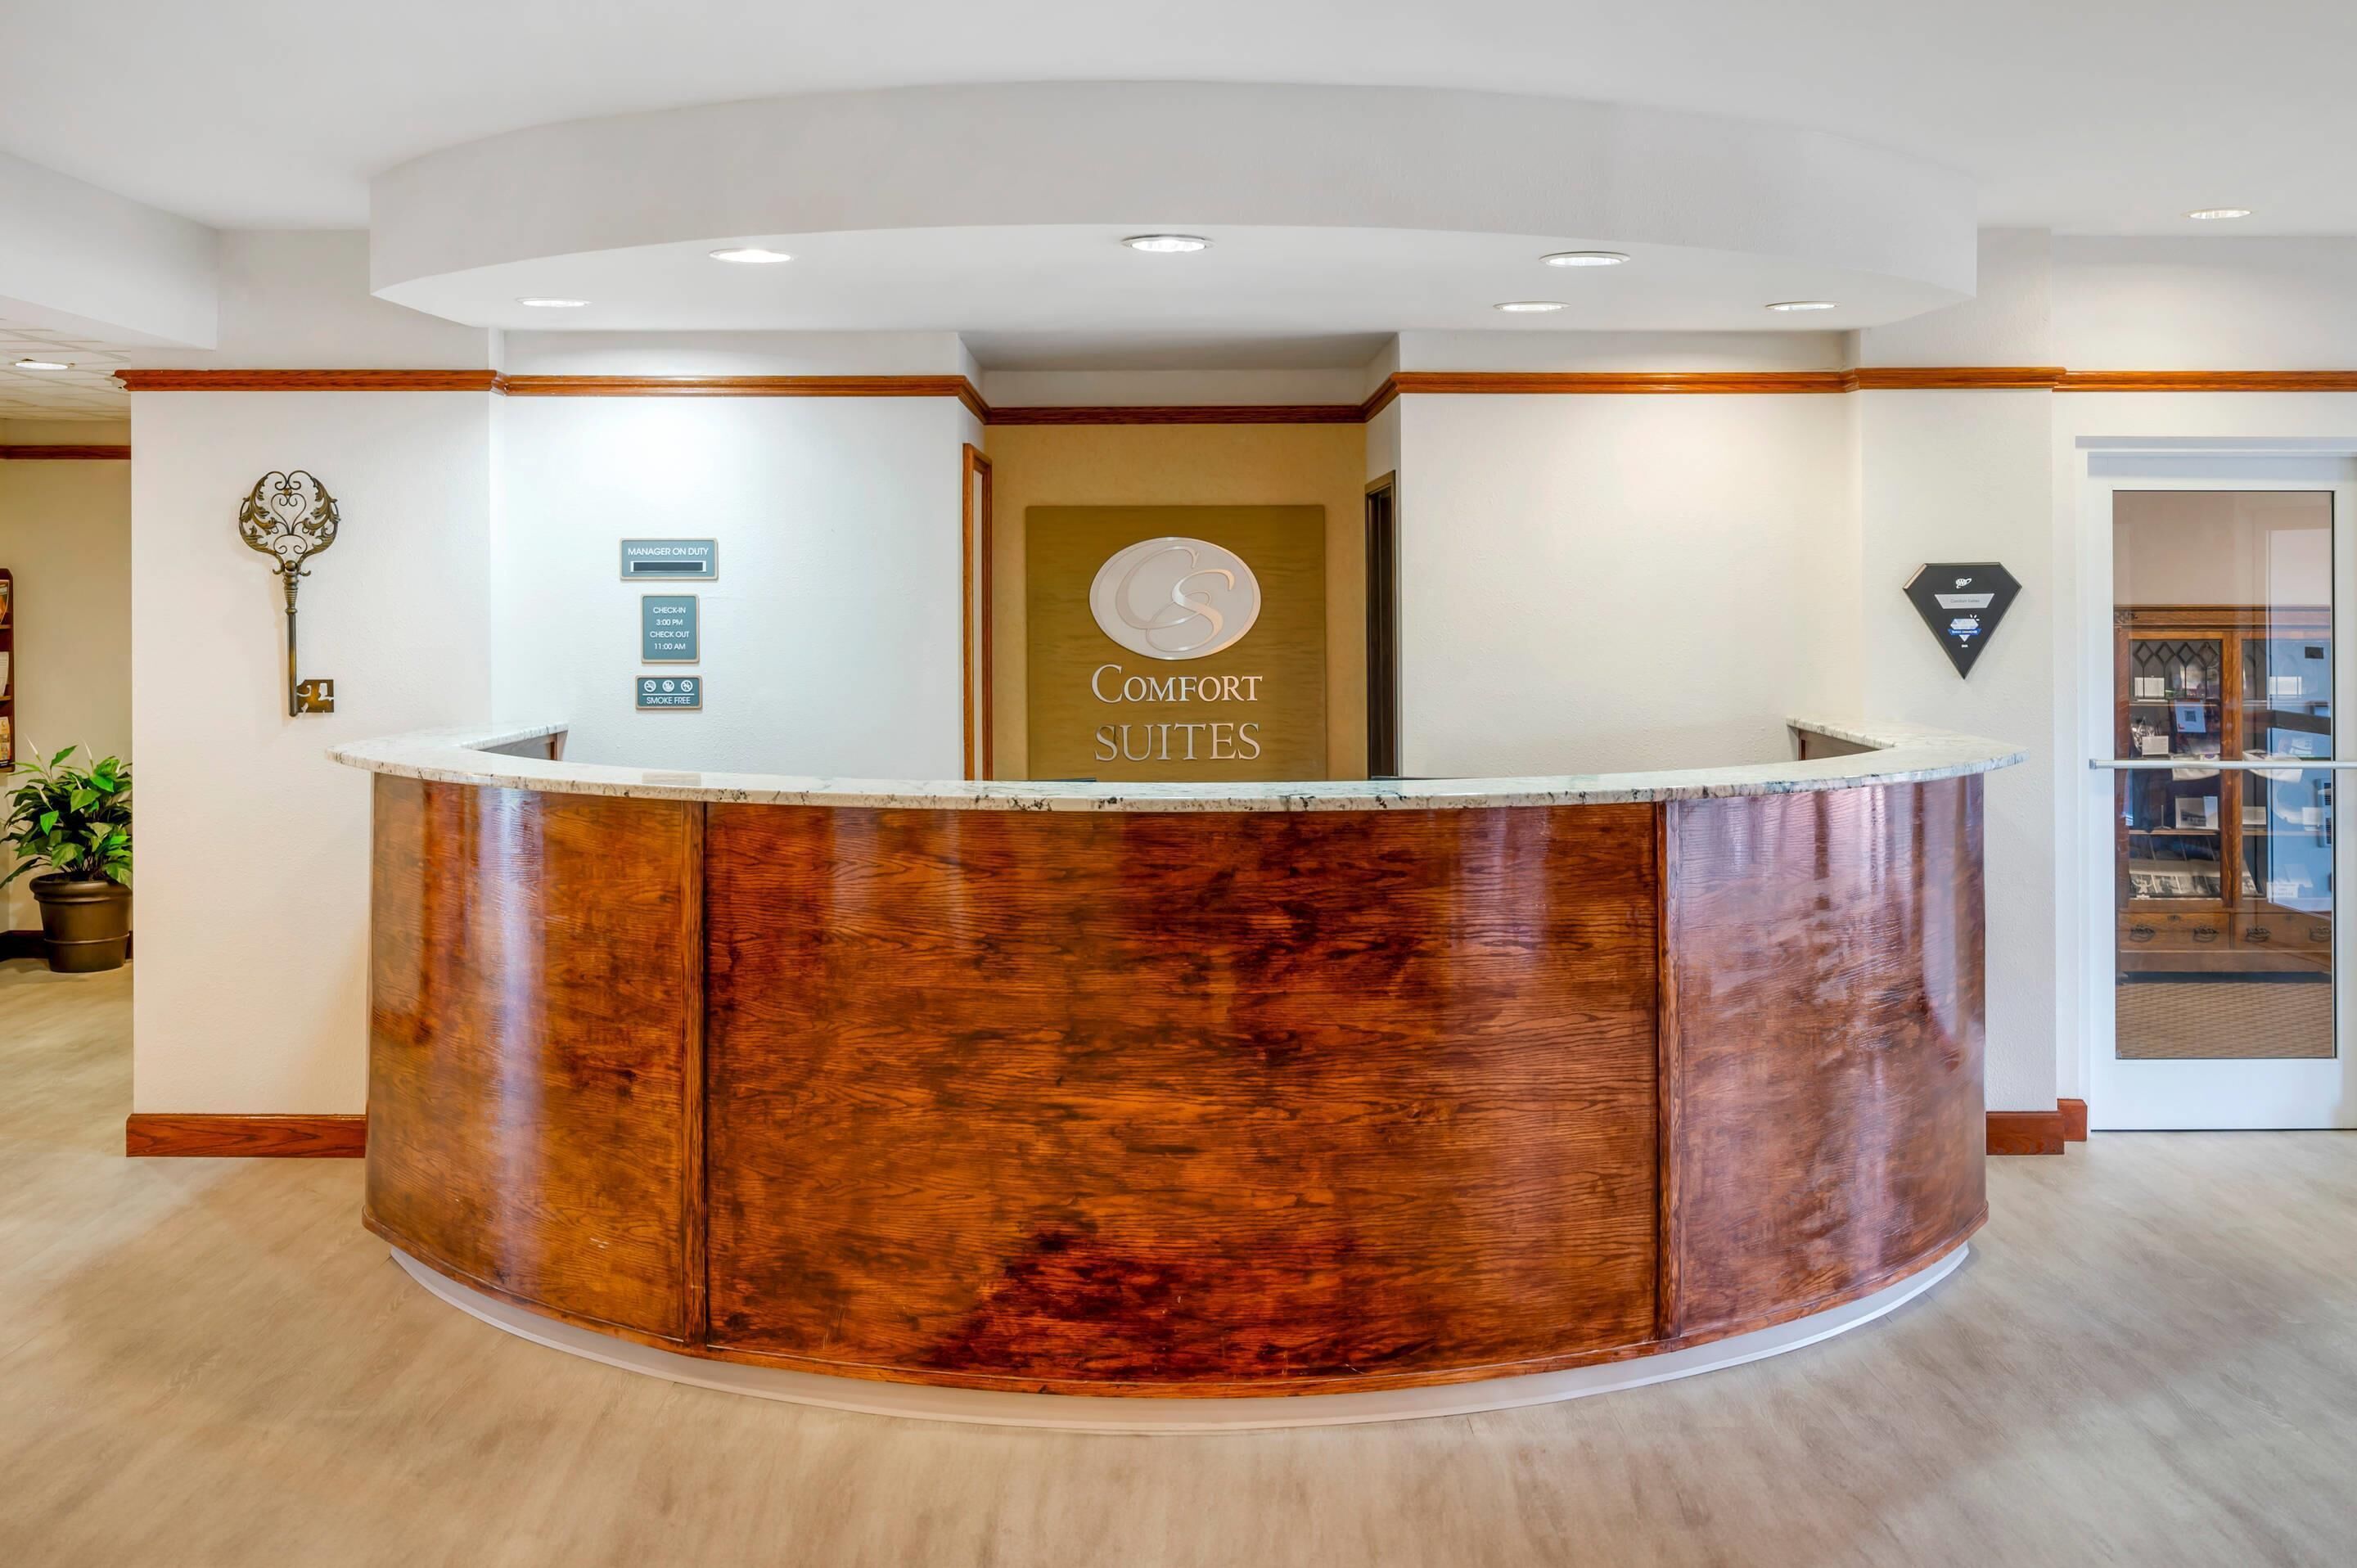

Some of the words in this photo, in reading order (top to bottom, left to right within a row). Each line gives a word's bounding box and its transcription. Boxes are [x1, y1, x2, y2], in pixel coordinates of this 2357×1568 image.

[628, 547, 671, 556] MANAGER
[672, 547, 687, 556] ON
[687, 547, 709, 556] DUTY
[1091, 664, 1264, 704] COMFORT
[647, 696, 673, 705] SMOKE
[674, 696, 691, 705] FREE
[1094, 722, 1261, 762] SUITES
